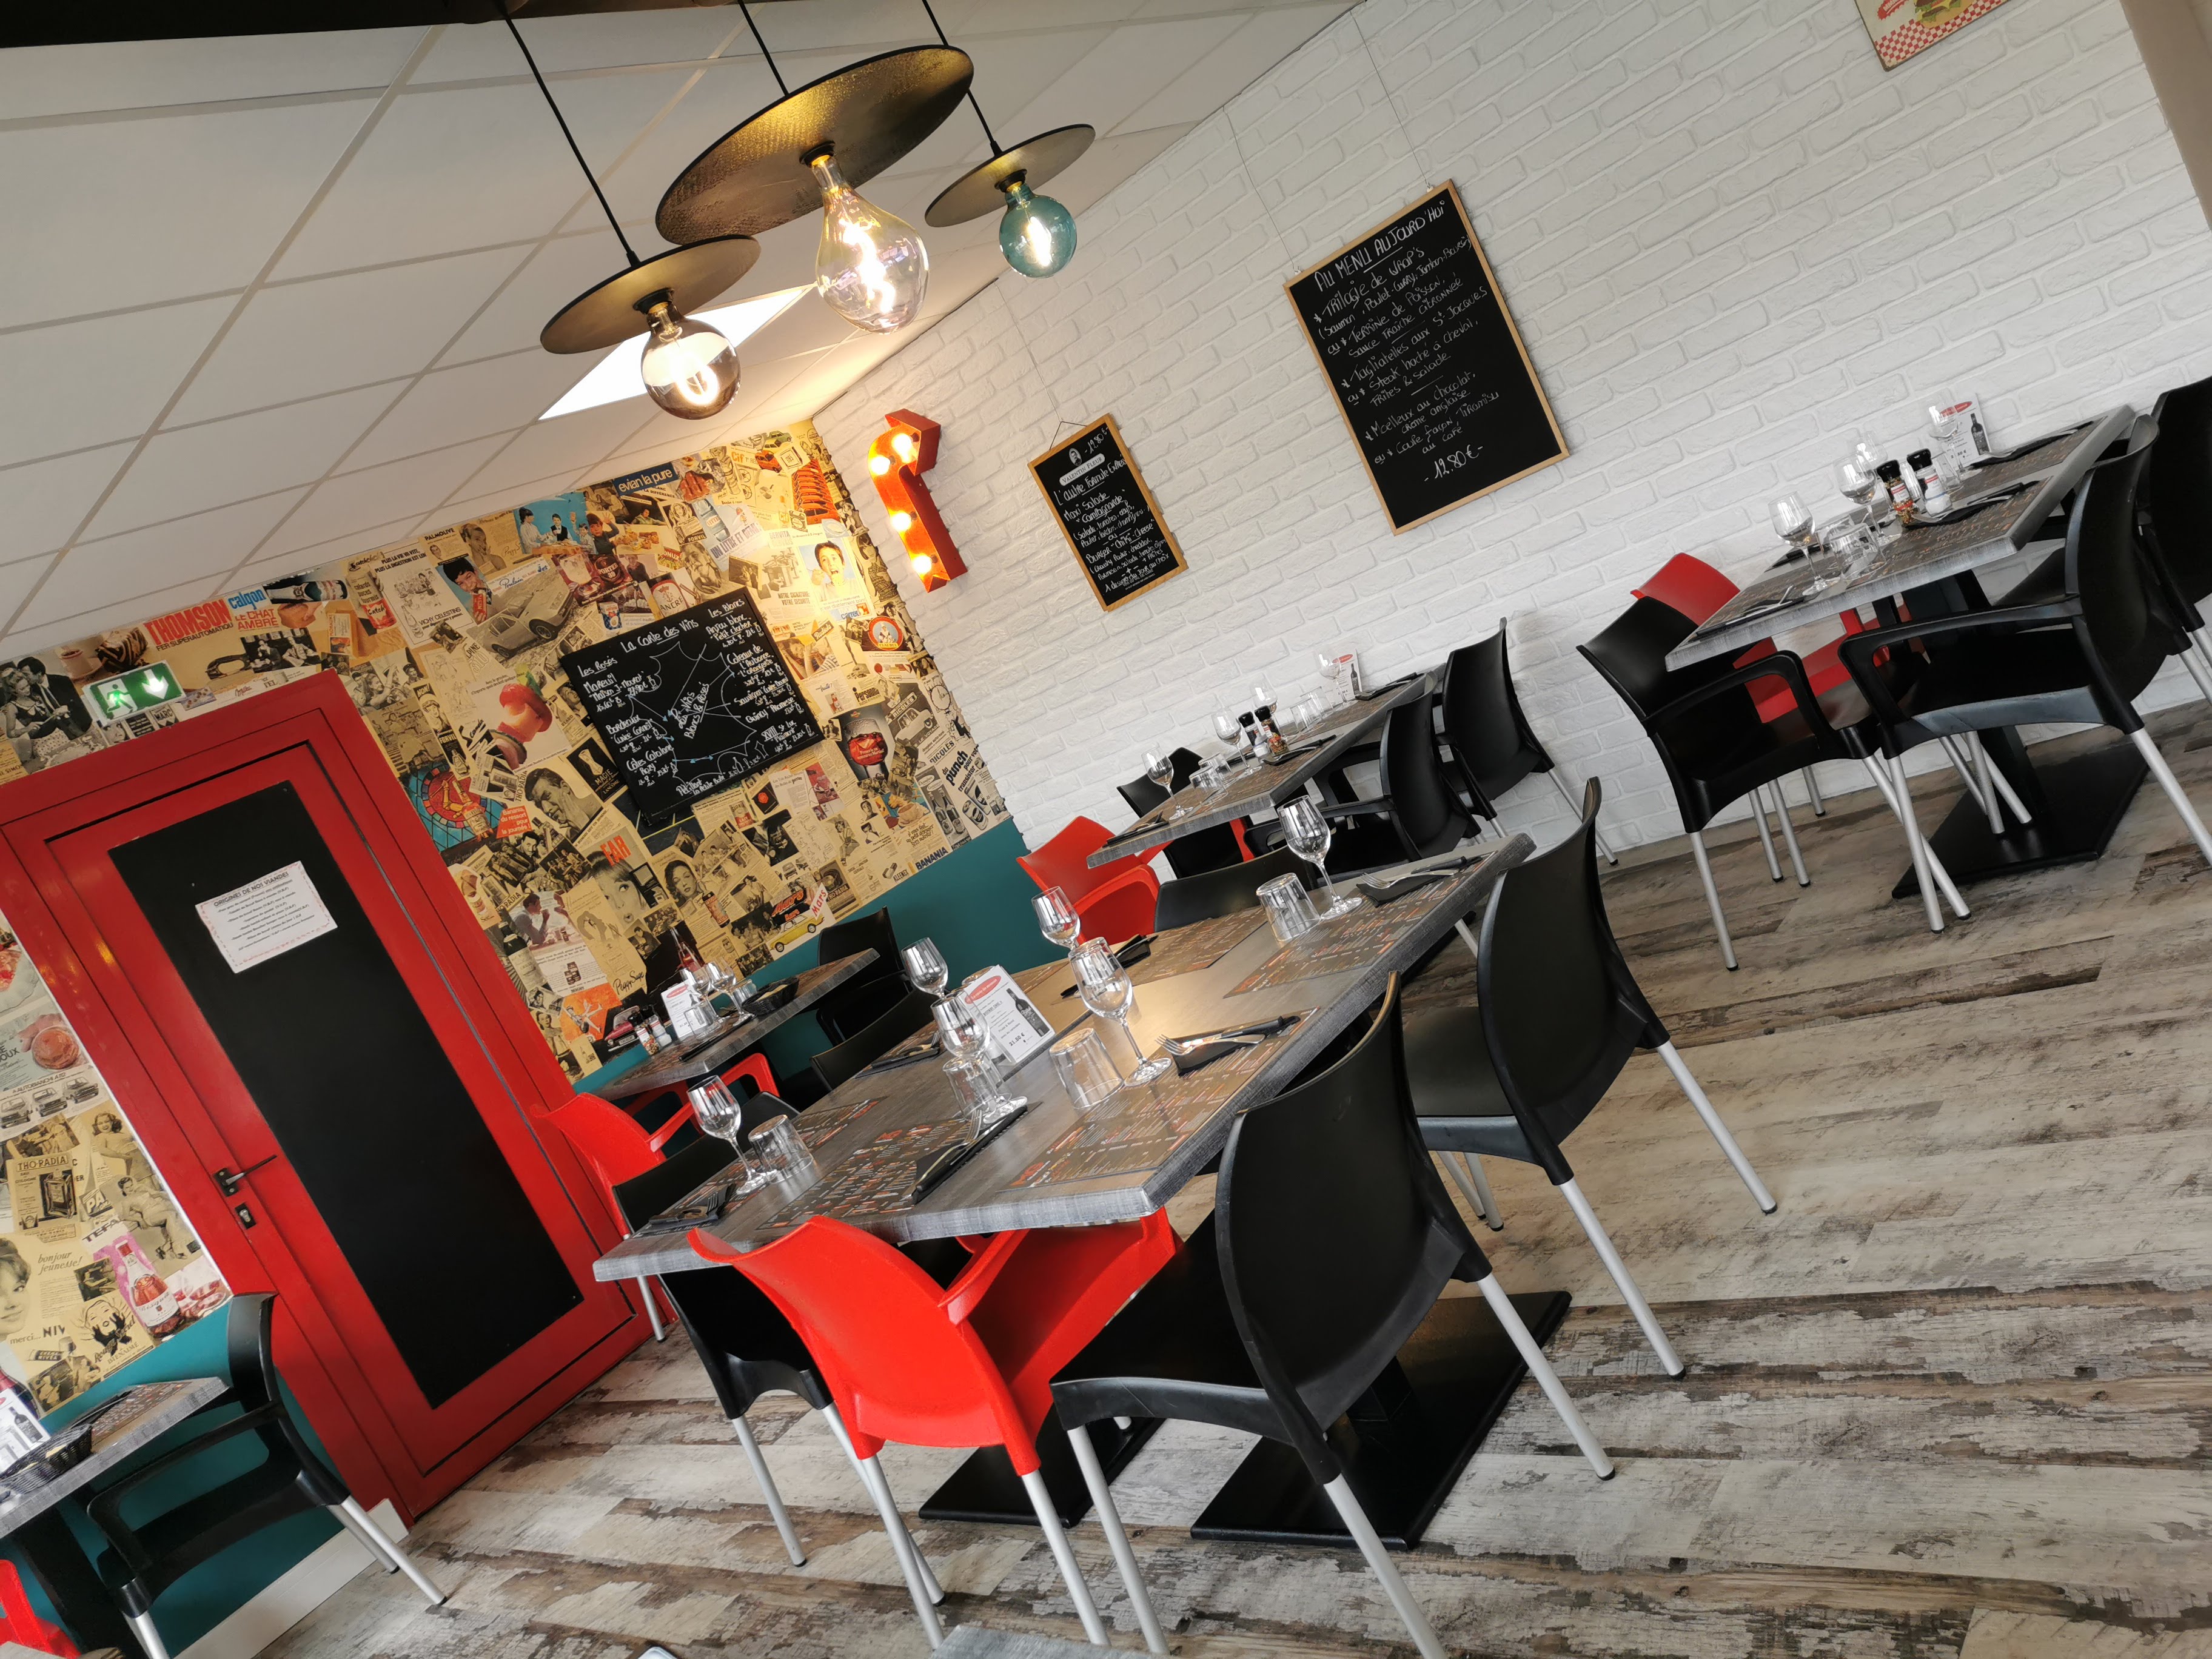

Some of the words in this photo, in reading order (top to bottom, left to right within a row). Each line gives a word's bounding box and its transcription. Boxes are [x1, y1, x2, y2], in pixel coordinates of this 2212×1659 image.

[1314, 270, 1336, 292] AU
[1335, 247, 1372, 279] MENU
[1370, 272, 1387, 289] de
[1392, 301, 1406, 317] de
[1411, 328, 1430, 345] aux
[1369, 367, 1399, 389] Steak
[731, 451, 744, 463] Cif
[618, 477, 643, 493] evian
[643, 474, 652, 485] la
[651, 468, 674, 485] pure
[1082, 492, 1110, 511] Salade
[424, 528, 455, 541] PALMOLIVE
[688, 534, 708, 543] FORVIL
[708, 545, 724, 560] UN
[717, 535, 739, 552] LITRE
[391, 556, 412, 568] DIGESTION
[227, 589, 267, 610] calgon
[660, 595, 684, 611] ANCRE
[708, 608, 724, 618] Les
[721, 598, 745, 612] Blancs
[143, 598, 232, 646] THOMSON
[246, 608, 275, 620] CHAT
[620, 641, 637, 653] La
[637, 631, 663, 646] Carte
[663, 626, 680, 638] des
[679, 619, 699, 632] Vins
[752, 643, 763, 654] de
[577, 665, 595, 677] Les
[153, 708, 173, 719] MARC
[605, 712, 642, 735] Bordeaux
[594, 768, 613, 785] MAGIE
[945, 749, 969, 786] punch
[508, 812, 527, 822] ressort
[600, 834, 631, 867] FAR
[914, 846, 949, 871] BANANIA
[213, 892, 241, 907] ORIGINES
[263, 871, 289, 885] VIANDES
[813, 890, 827, 917] Mars
[38, 1251, 73, 1264] bonjour
